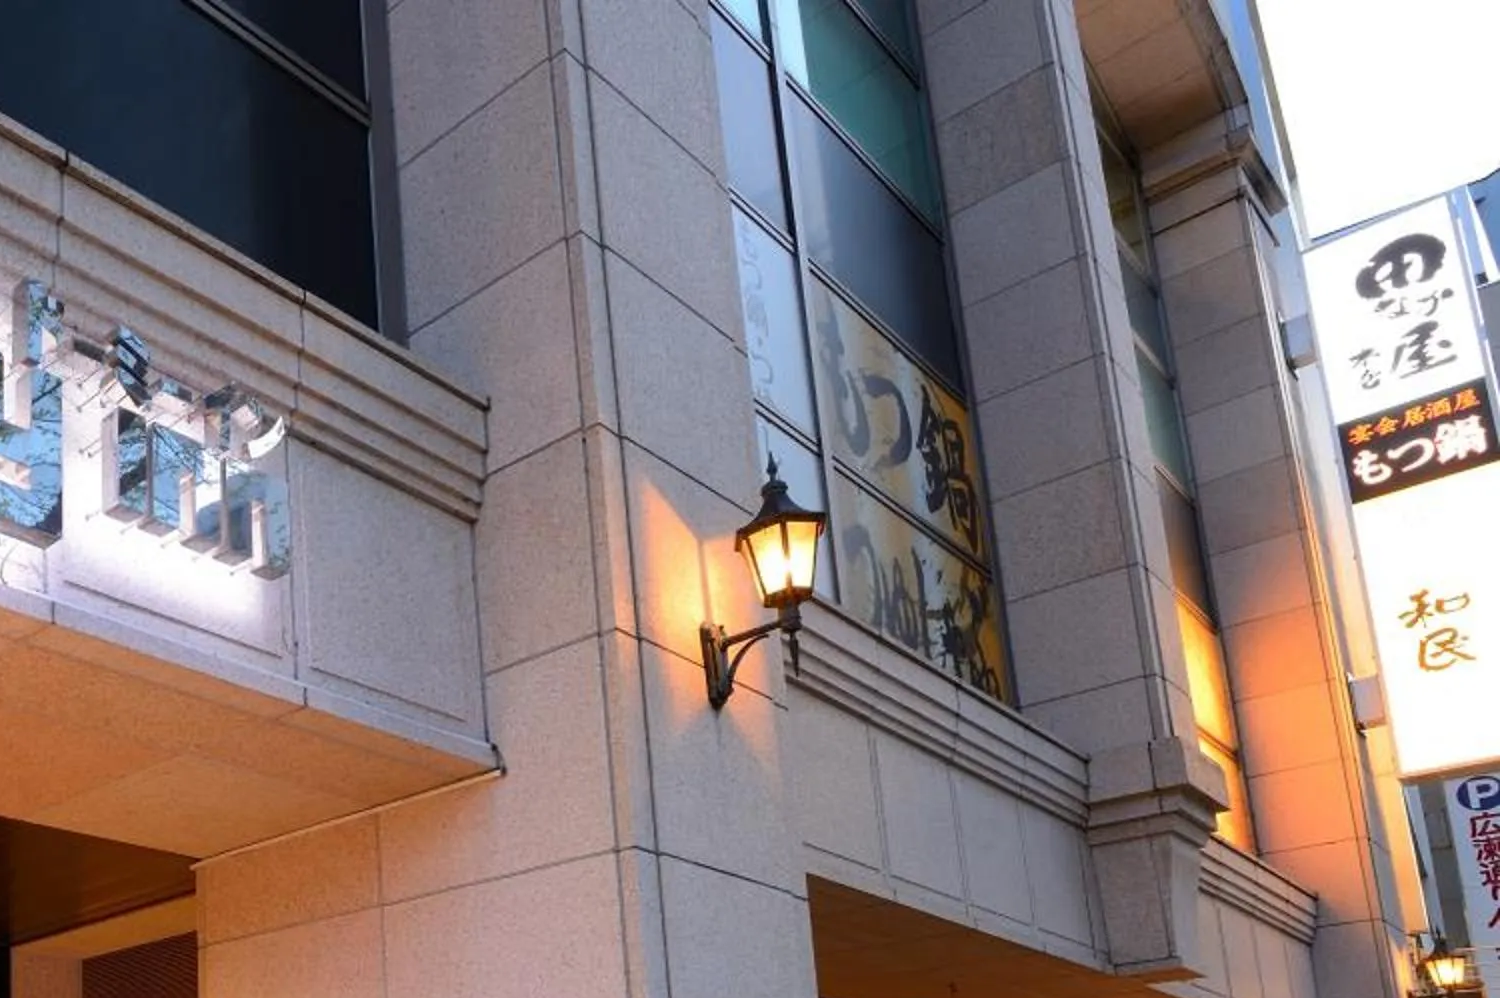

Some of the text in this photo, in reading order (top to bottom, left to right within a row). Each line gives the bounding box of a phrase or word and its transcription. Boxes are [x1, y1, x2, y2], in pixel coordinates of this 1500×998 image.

[1352, 415, 1489, 486] もつ鍋
[100, 405, 291, 582] inn
[1398, 588, 1477, 672] 和民
[1466, 780, 1500, 809] P
